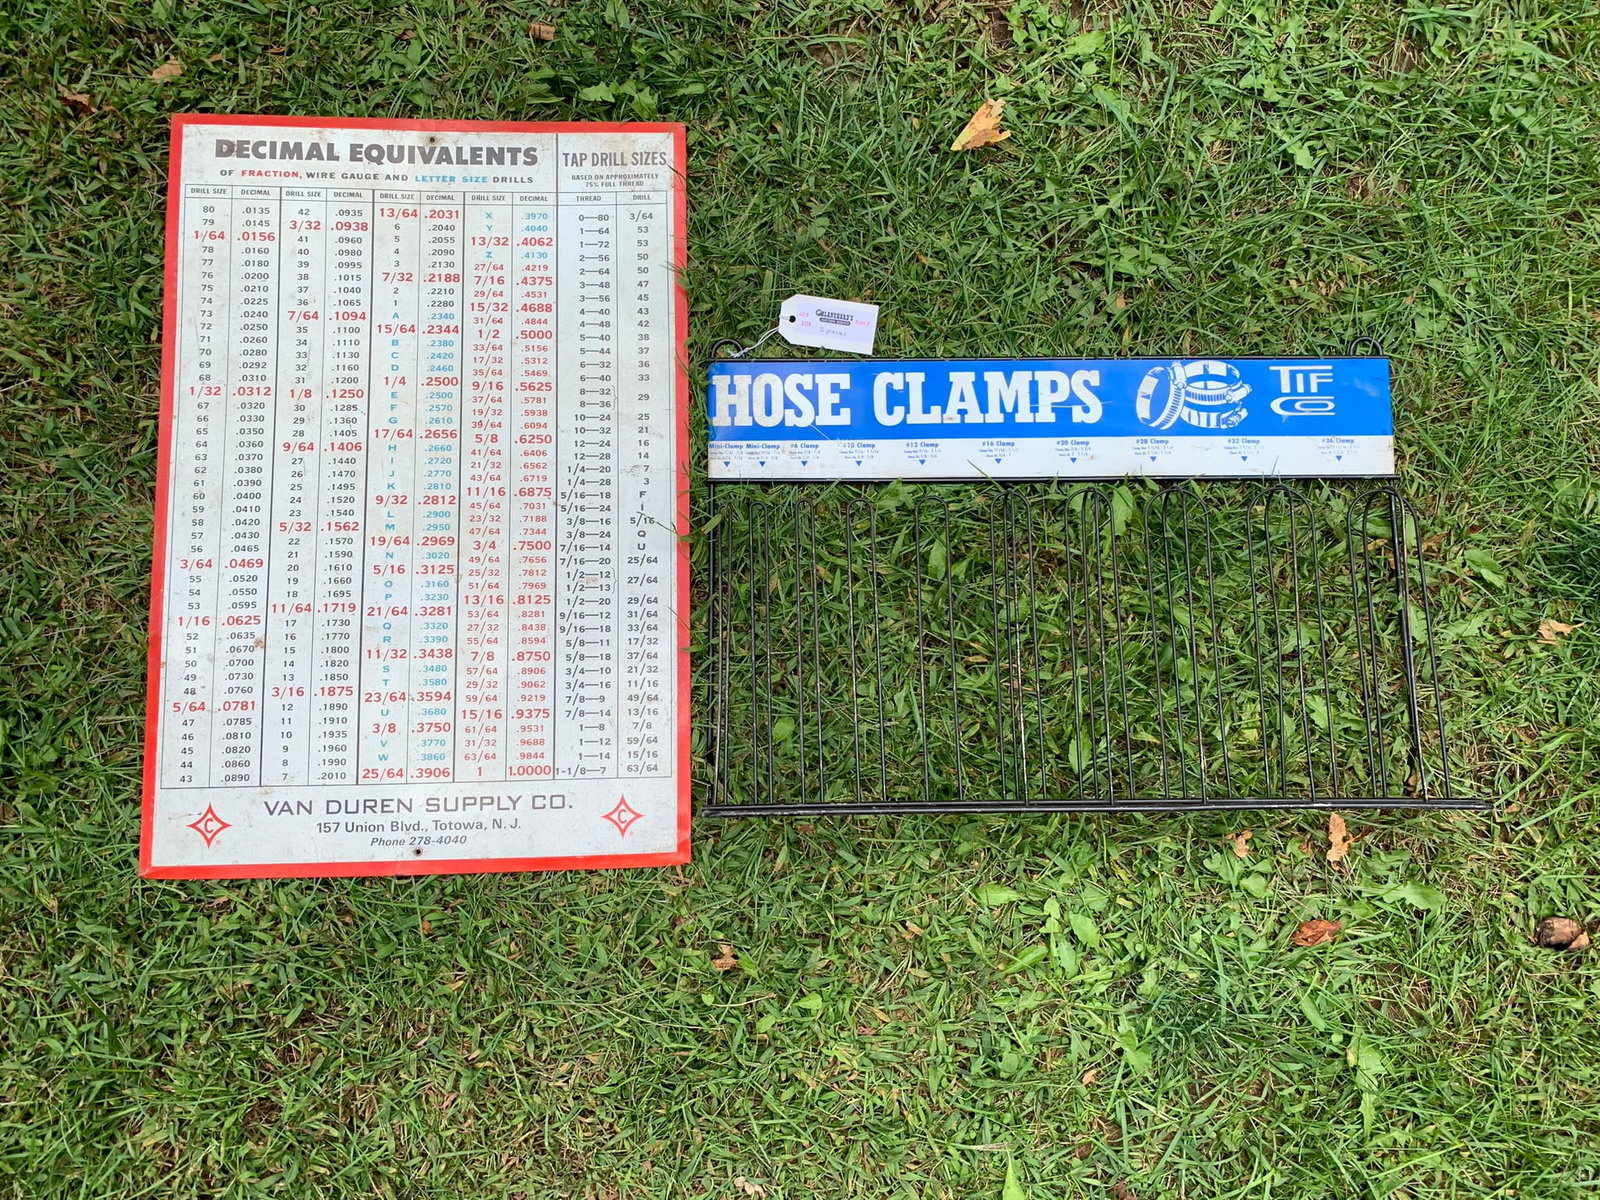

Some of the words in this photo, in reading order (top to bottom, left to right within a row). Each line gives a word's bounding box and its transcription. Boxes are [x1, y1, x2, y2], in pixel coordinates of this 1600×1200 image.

[215, 139, 340, 161] DECIMAL
[349, 143, 538, 166] EQUIVALENTS
[562, 153, 587, 167] TAP
[586, 152, 629, 166] DRILL
[631, 151, 666, 166] SIZES
[241, 170, 302, 179] FRACTION,
[298, 208, 310, 216] 42
[335, 209, 363, 217] .0935
[380, 208, 418, 220] 13/64
[425, 209, 459, 219] .2031
[629, 210, 653, 222] 3/64
[289, 220, 321, 232] 3/32
[331, 221, 368, 231] .0938
[194, 230, 225, 243] 1/64
[237, 231, 275, 241] .0156
[471, 236, 509, 248] 13/32
[517, 237, 553, 246] .4062
[382, 272, 413, 284] 7/32
[423, 273, 460, 283] .2188
[474, 275, 505, 287] 7/16
[516, 276, 552, 286] .4375
[288, 311, 319, 323] 7/64
[329, 311, 366, 321] .1094
[377, 324, 416, 336] 15/64
[422, 325, 459, 334] .2344
[478, 329, 500, 341] 1/2
[516, 330, 552, 340] .5000
[384, 376, 406, 388] 1/4
[421, 377, 459, 386] .2500
[472, 381, 504, 393] 9/16
[515, 382, 552, 391] .5625
[190, 386, 221, 398] 1/32
[233, 386, 271, 396] .0312
[290, 389, 312, 401] 1/8
[326, 389, 364, 399] .1250
[712, 373, 851, 427] HOSE
[873, 370, 1103, 426] CLAMPS
[375, 428, 413, 441] 17/64
[420, 429, 457, 439] .2656
[283, 442, 314, 454] 9/64
[324, 442, 362, 452] .1406
[996, 440, 1015, 448] Clamp
[470, 472, 501, 484] 43/64
[376, 495, 407, 507] 9/32
[418, 495, 456, 505] .2812
[280, 522, 311, 534] 5/32
[321, 521, 359, 531] .1562
[180, 559, 212, 572] 3/64
[225, 558, 263, 568] .0469
[373, 564, 405, 577] 5/16
[416, 565, 454, 574] .3125
[464, 595, 504, 607] 13/16
[512, 595, 551, 605] .8125
[367, 606, 408, 619] 21/64
[415, 606, 451, 616] .3281
[178, 616, 210, 629] 1/16
[222, 615, 261, 626] .0625
[272, 687, 304, 700] 3/16
[314, 686, 353, 696] .1875
[462, 709, 502, 722] 15/16
[511, 708, 550, 719] .9375
[628, 705, 658, 718] 13/16
[632, 719, 652, 732] 7/8
[181, 733, 194, 741] 46
[222, 731, 251, 740] .0810
[180, 775, 192, 783] 43
[221, 774, 250, 782] .0890
[362, 768, 404, 782] 25/64
[411, 767, 450, 778] .3906
[264, 800, 312, 816] VAN
[326, 798, 412, 815] DUREN
[425, 795, 522, 812] SUPPLY
[532, 795, 573, 810] CO.
[317, 822, 339, 833] 157
[345, 821, 384, 833] Union
[391, 820, 428, 832] Blvd.,
[433, 819, 487, 831] Totowa,
[370, 837, 405, 847] Phone
[410, 835, 467, 846] 278-4040
